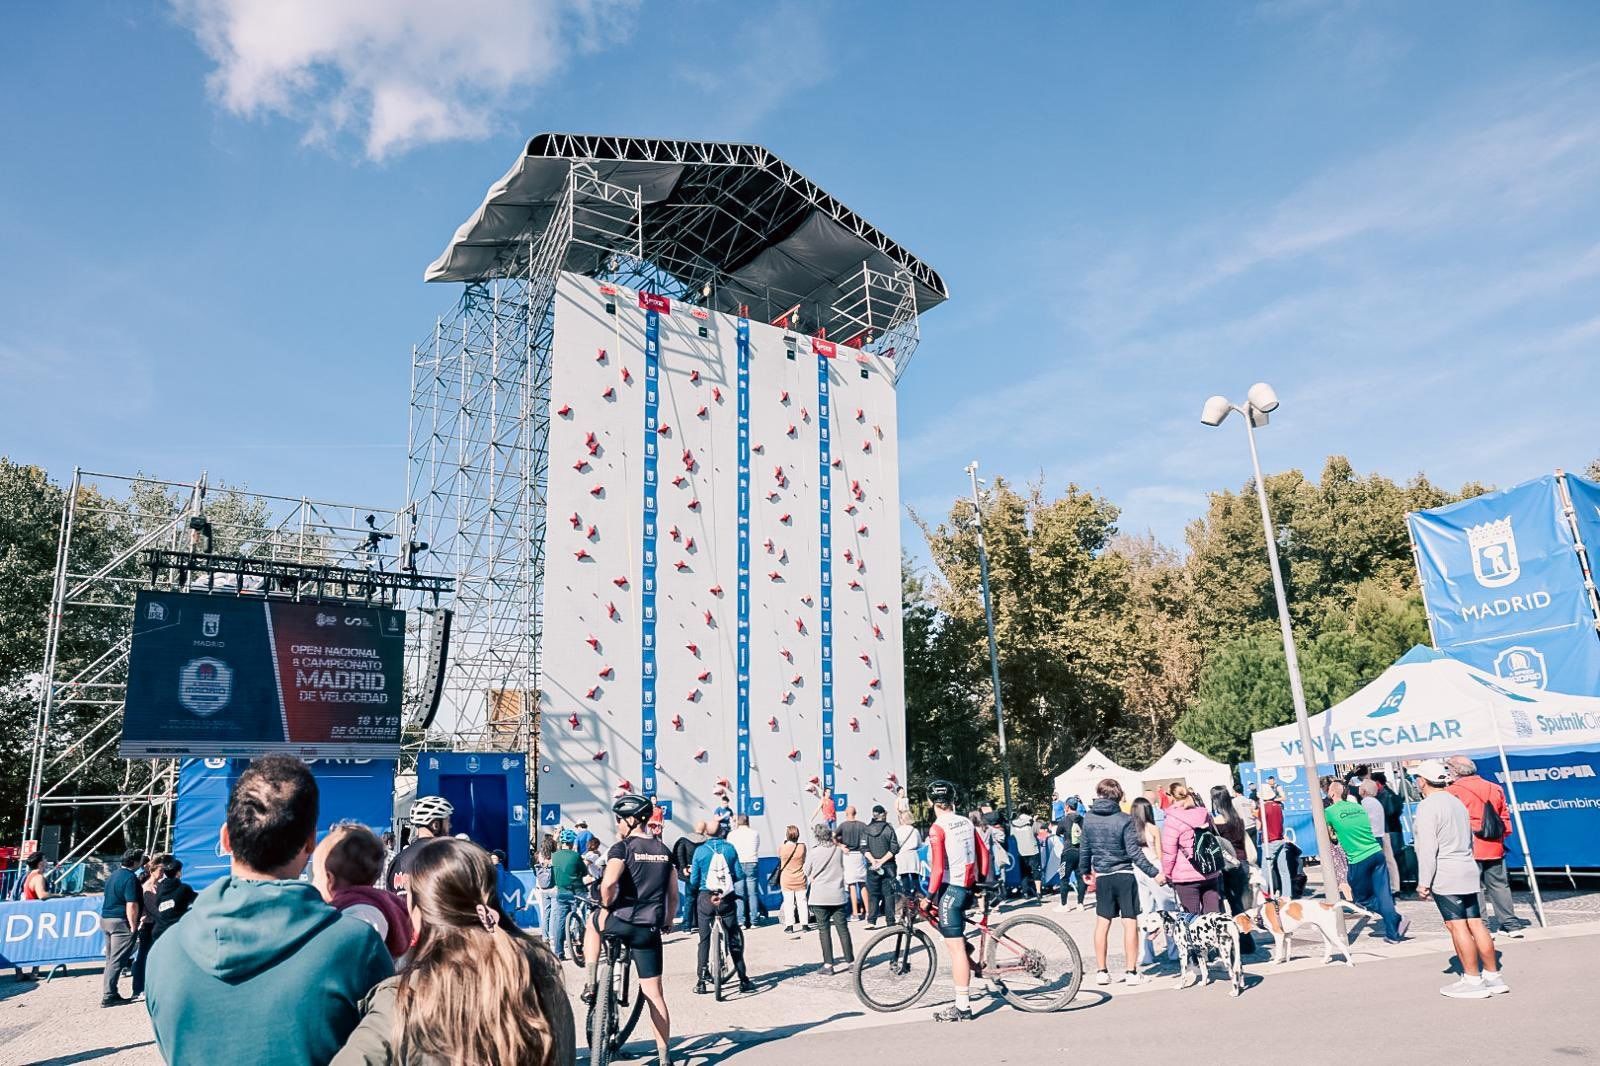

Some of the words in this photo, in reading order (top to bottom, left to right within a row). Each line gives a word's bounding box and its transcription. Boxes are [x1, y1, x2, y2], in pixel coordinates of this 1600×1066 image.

[1461, 591, 1552, 622] MADRID
[291, 645, 322, 655] OPEN
[325, 647, 380, 659] NACIONAL
[302, 658, 382, 671] CAMPEONATO
[296, 669, 386, 691] MADRID
[300, 690, 317, 701] DE
[320, 691, 388, 704] VELOCIDAD
[374, 716, 383, 726] Y
[331, 726, 346, 735] DE
[348, 726, 399, 736] OCTUBRE
[1331, 732, 1346, 752] A
[1351, 719, 1463, 749] ESCALAR
[752, 801, 761, 811] C
[838, 798, 844, 807] D
[545, 810, 555, 820] A
[5, 910, 100, 943] DRID
